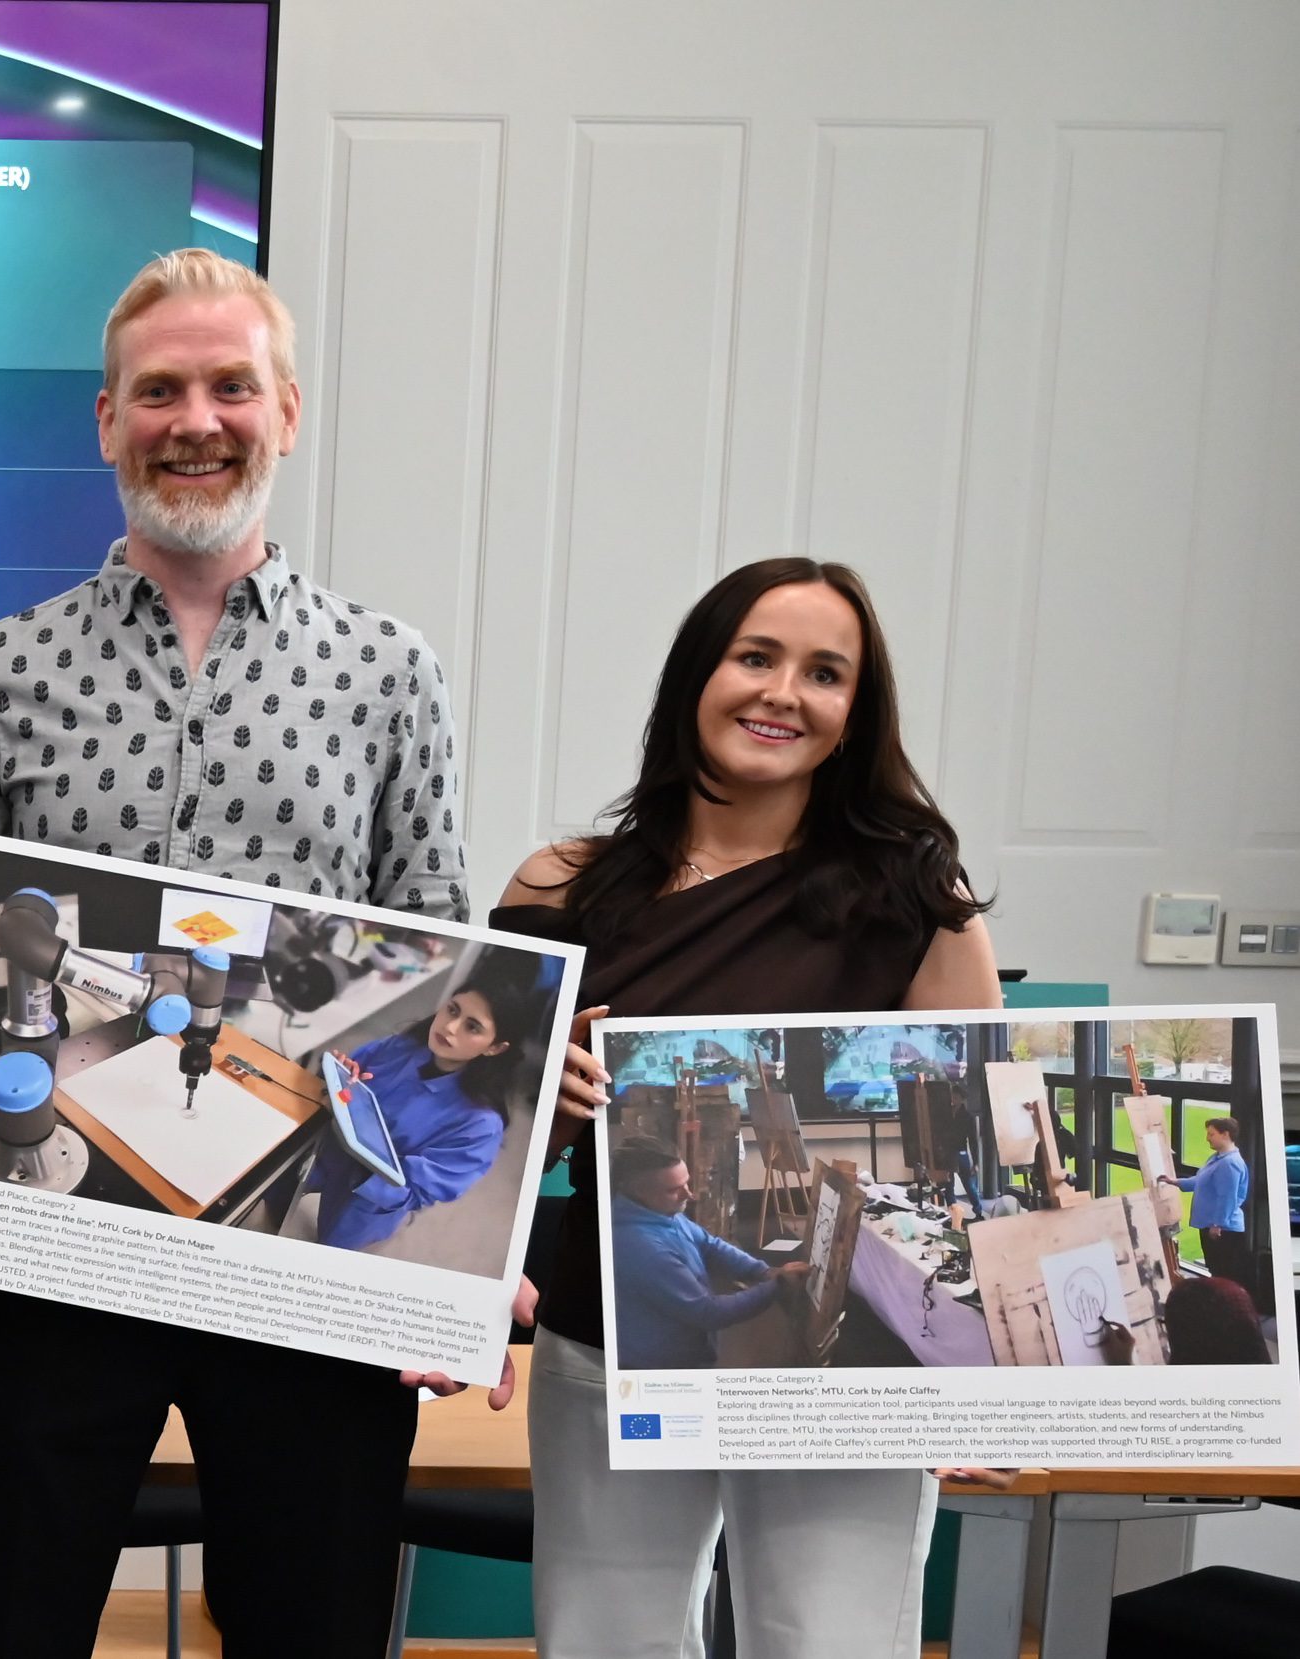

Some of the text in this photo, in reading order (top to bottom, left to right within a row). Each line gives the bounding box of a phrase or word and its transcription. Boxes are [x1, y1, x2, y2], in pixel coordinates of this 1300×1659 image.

[82, 978, 123, 1000] Nimbus
[7, 1190, 29, 1202] Place,
[31, 1196, 68, 1210] Category
[11, 1206, 37, 1216] robots
[39, 1210, 60, 1220] draw
[61, 1214, 75, 1223] the
[97, 1221, 119, 1232] MTU,
[122, 1226, 141, 1236] Cork
[143, 1230, 153, 1240] by
[155, 1232, 166, 1240] Dr
[166, 1235, 185, 1245] Alan
[187, 1239, 215, 1250] Magee
[715, 1375, 747, 1384] Second
[776, 1375, 816, 1384] Category
[817, 1374, 823, 1382] 2
[848, 1387, 868, 1395] Cork
[871, 1387, 881, 1395] by
[909, 1386, 940, 1396] Claffey
[717, 1401, 757, 1410] Exploring
[759, 1401, 793, 1409] drawing
[814, 1398, 880, 1408] communication
[904, 1399, 955, 1408] participants
[957, 1399, 978, 1407] used
[980, 1399, 1004, 1407] visual
[1007, 1399, 1045, 1408] language
[1060, 1399, 1096, 1408] navigate
[1124, 1398, 1157, 1407] beyond
[1191, 1398, 1225, 1407] building
